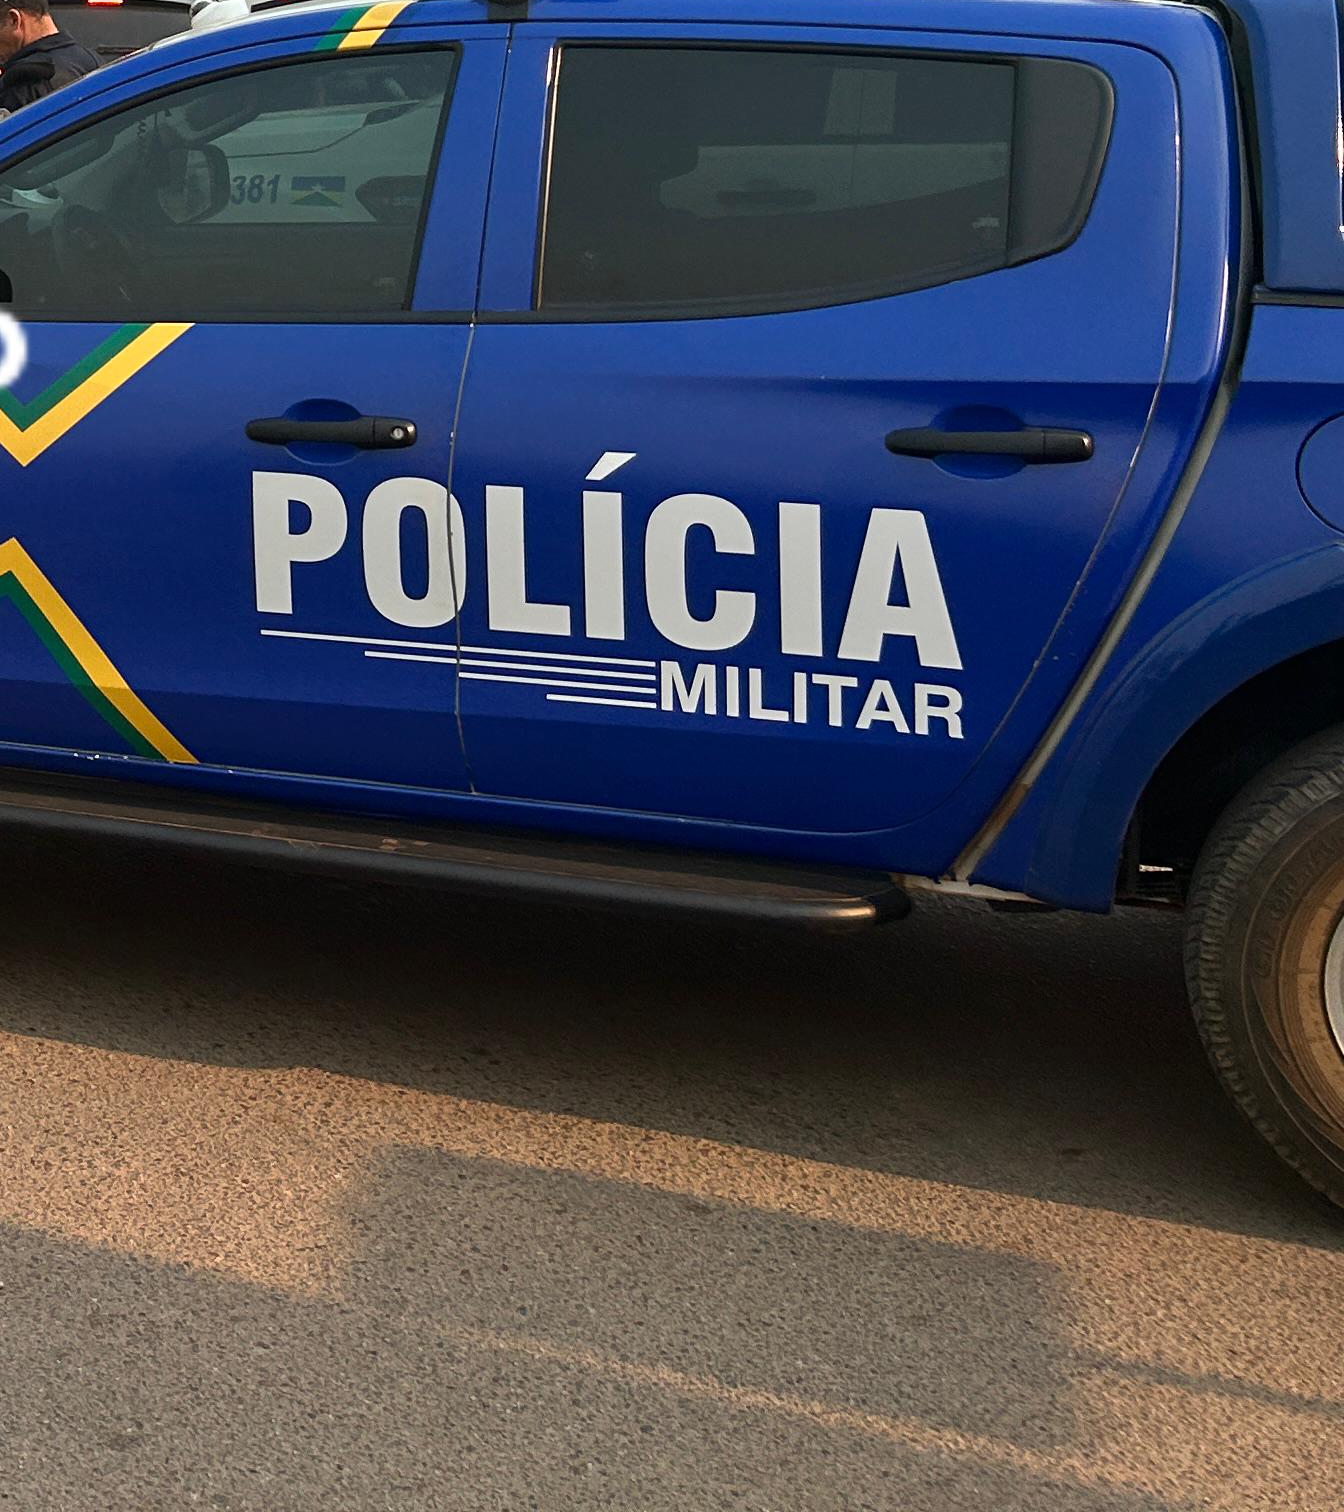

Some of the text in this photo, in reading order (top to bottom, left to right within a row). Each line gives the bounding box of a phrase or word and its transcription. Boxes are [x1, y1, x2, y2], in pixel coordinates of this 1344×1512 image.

[230, 174, 282, 205] 381
[251, 450, 965, 670] POLÍCIA
[659, 660, 966, 740] MILITAR
